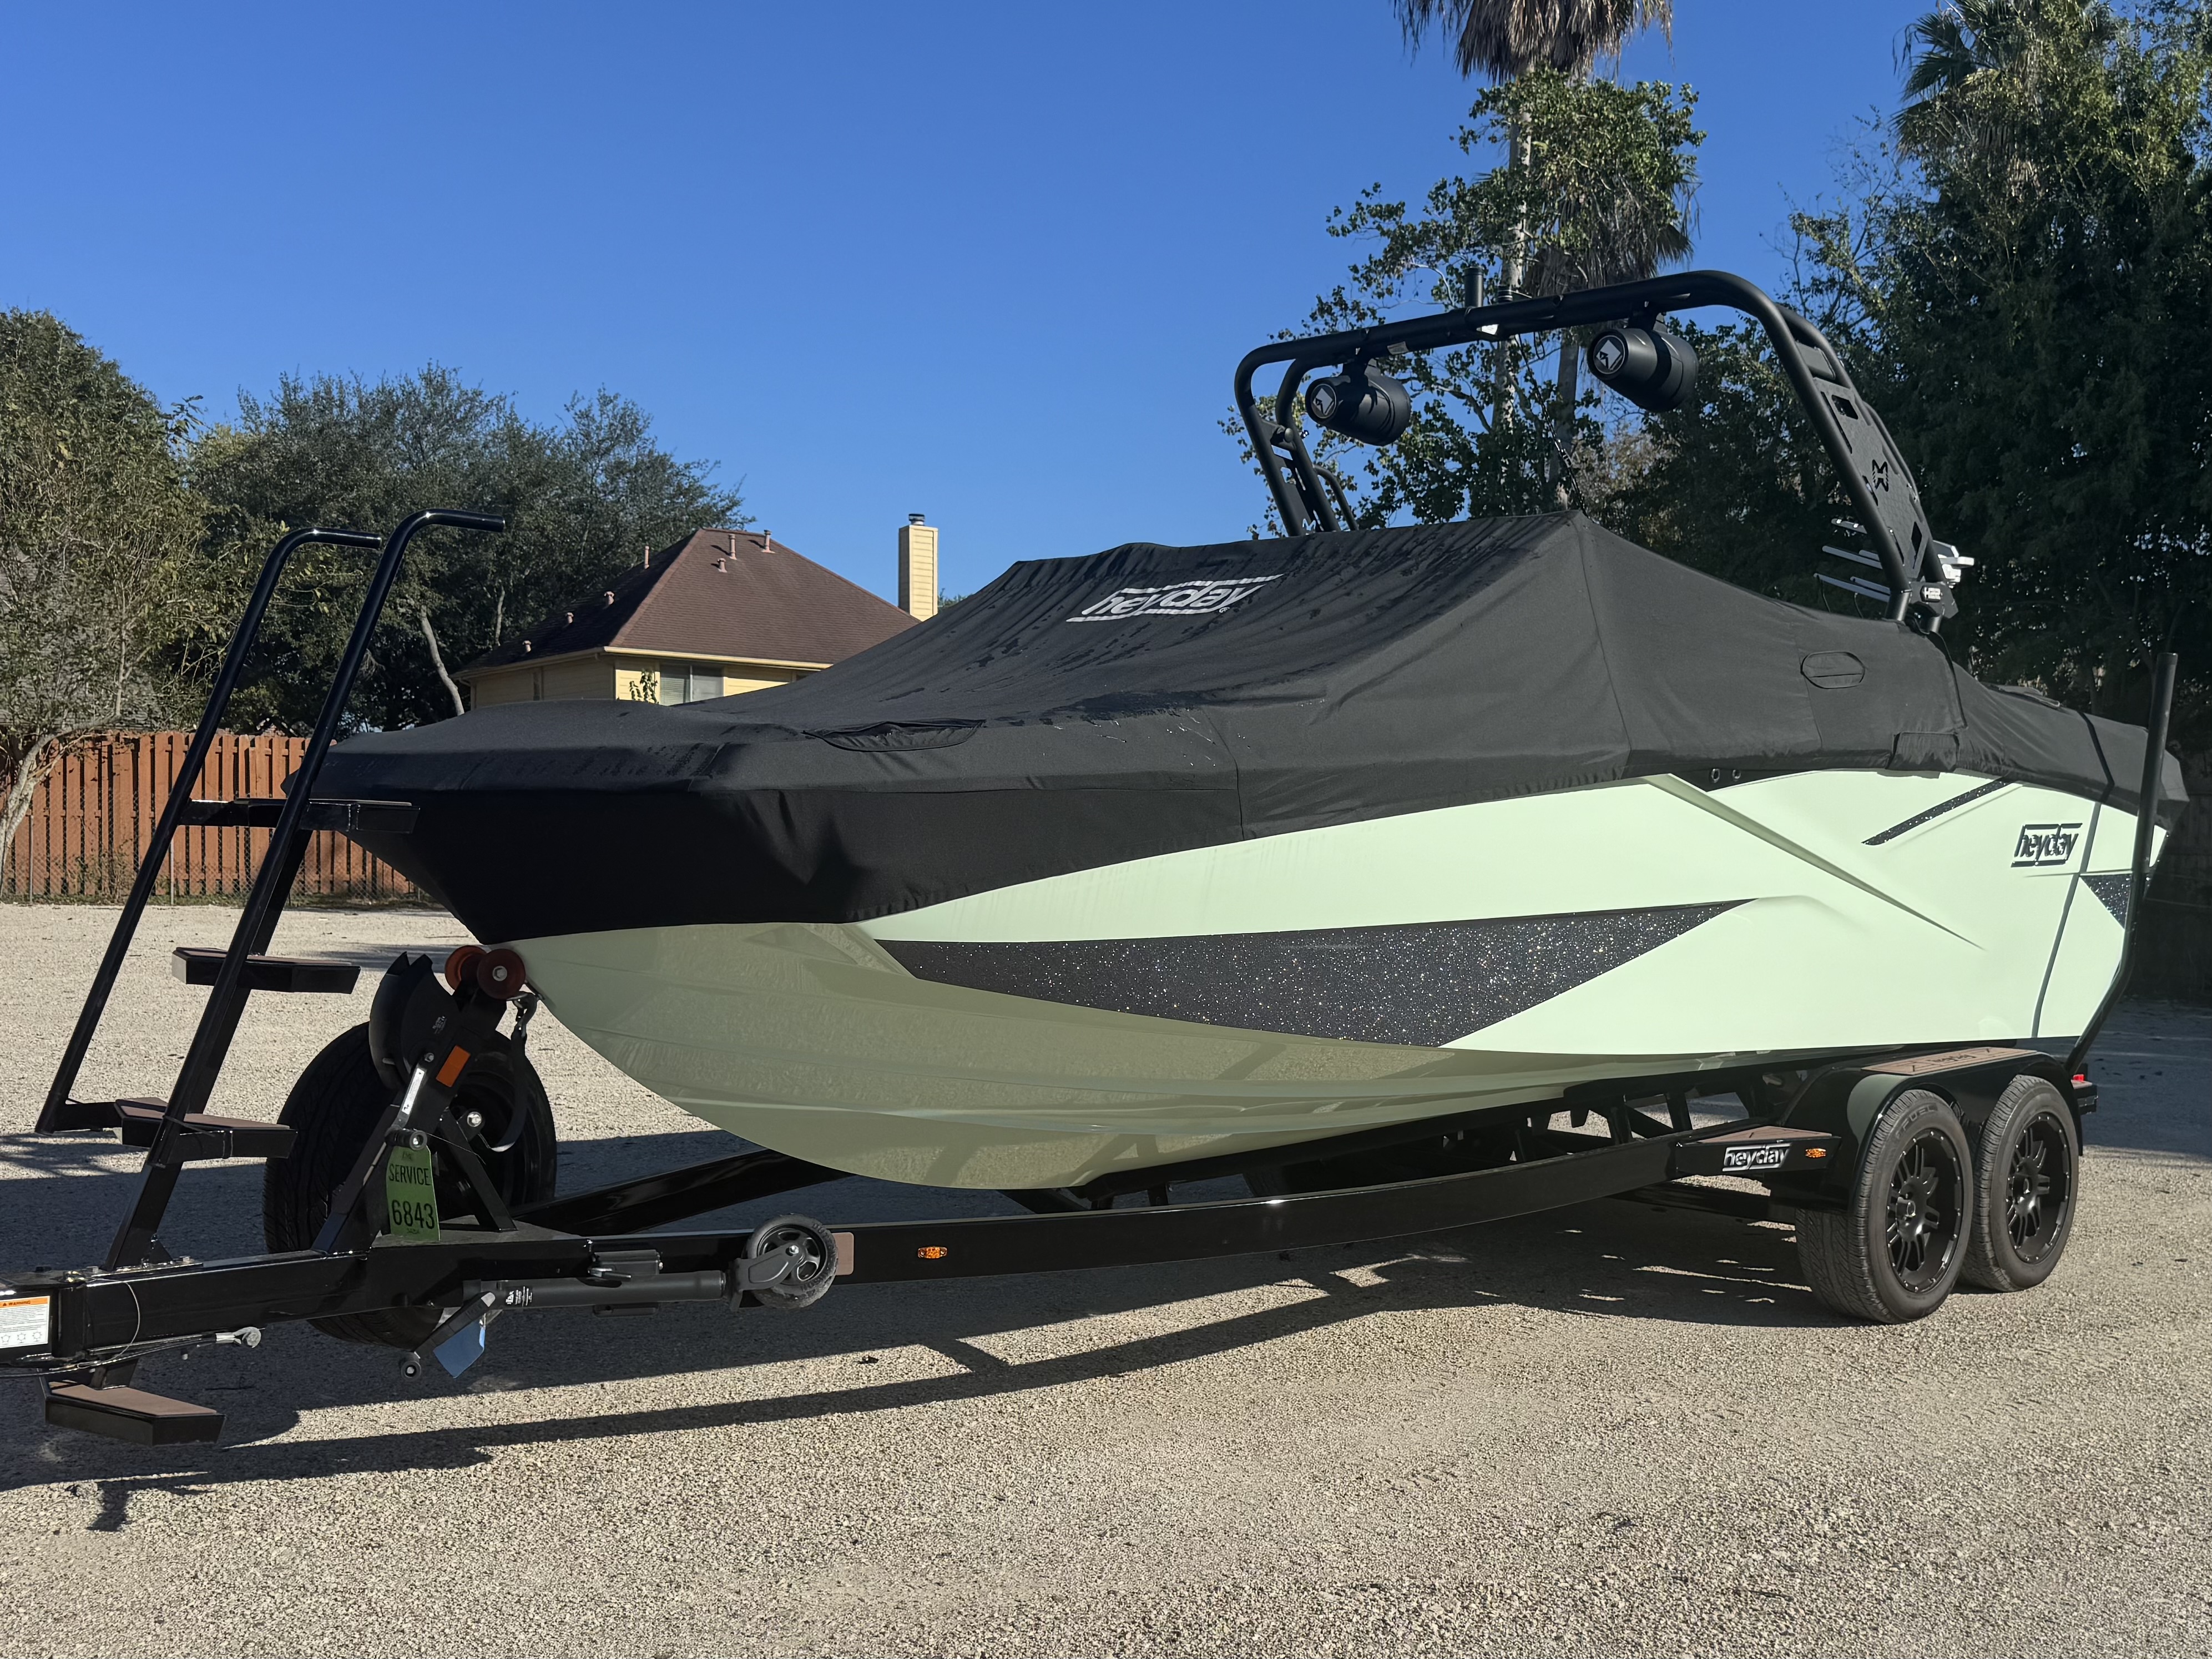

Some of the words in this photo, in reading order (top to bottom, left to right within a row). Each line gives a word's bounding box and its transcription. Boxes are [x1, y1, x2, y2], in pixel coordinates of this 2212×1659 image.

[1067, 574, 1283, 622] heyday
[2011, 823, 2082, 867] heyday
[1723, 1143, 1791, 1172] heyday
[389, 1163, 431, 1186] SERVICE
[392, 1200, 435, 1229] 6843
